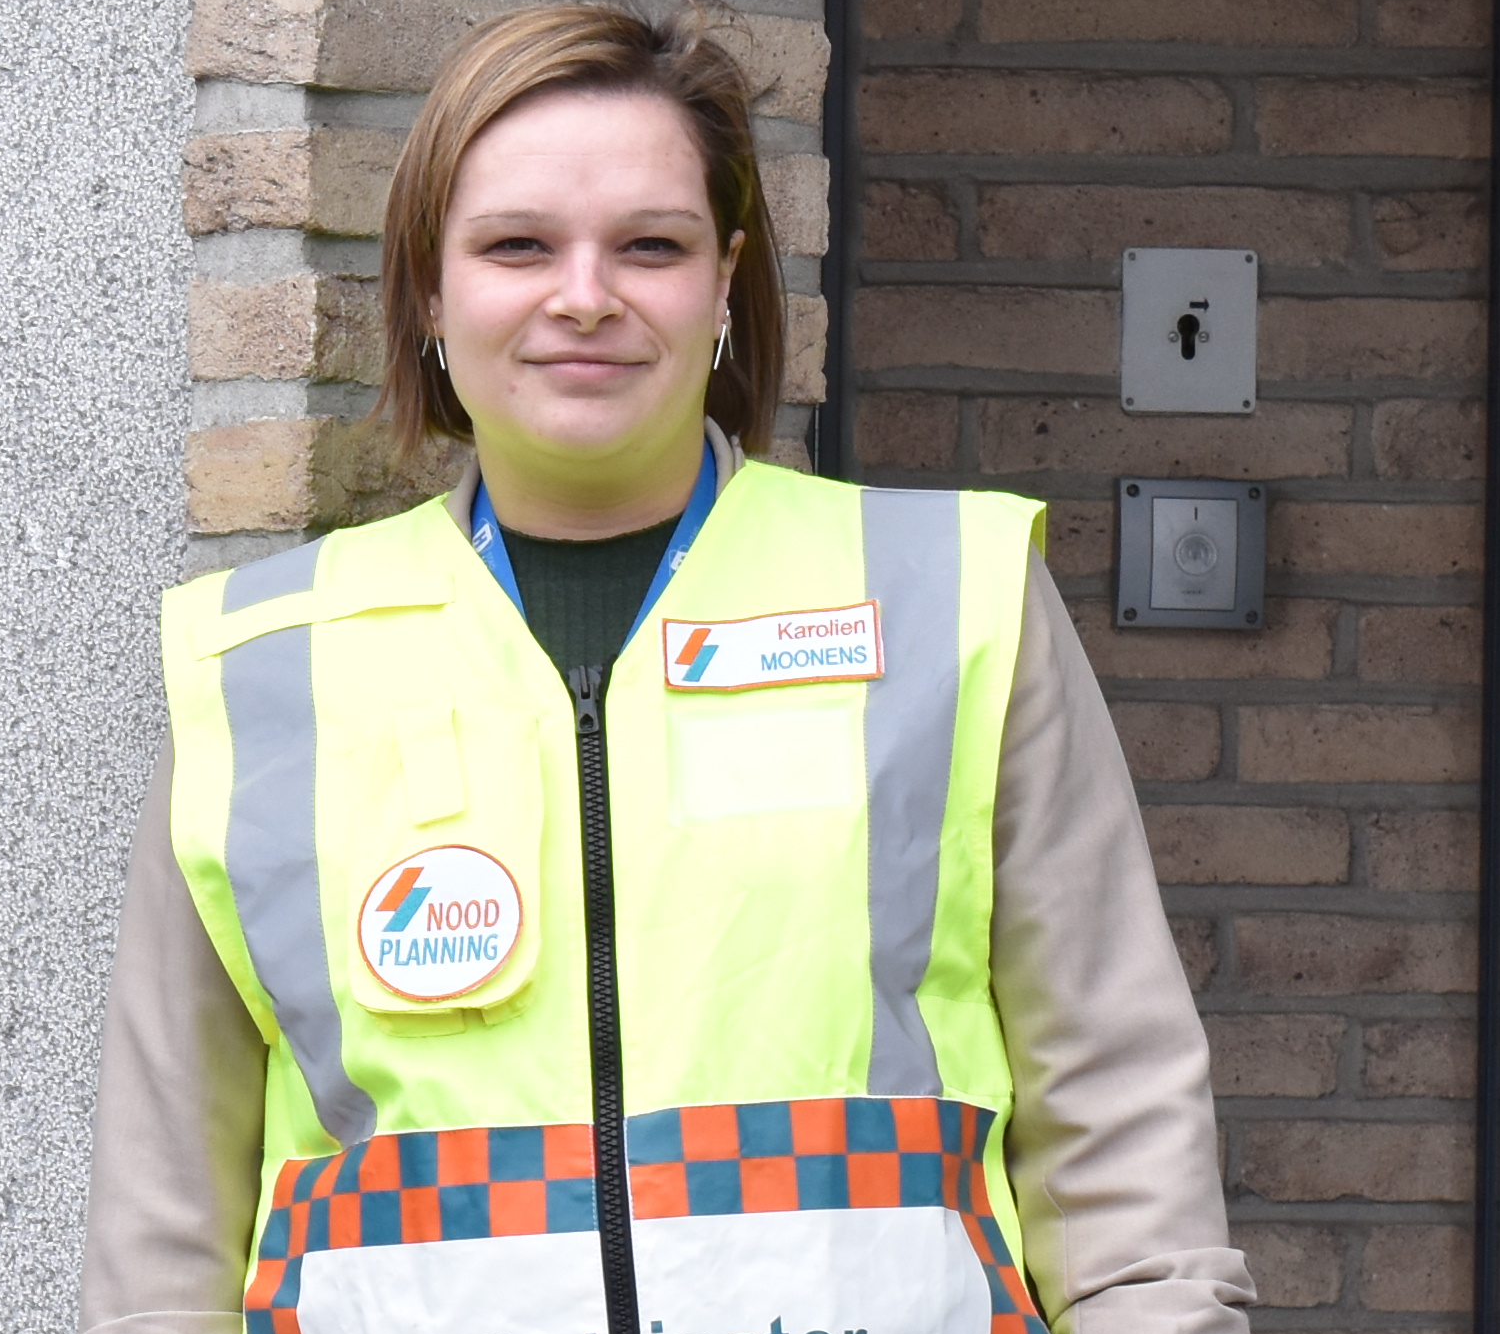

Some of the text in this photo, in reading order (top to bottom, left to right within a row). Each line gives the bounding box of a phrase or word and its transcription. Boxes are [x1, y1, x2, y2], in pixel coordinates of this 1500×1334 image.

[777, 618, 867, 641] Karolien
[760, 644, 868, 672] MOONENS
[426, 898, 500, 932] NOOD
[378, 933, 499, 967] PLANNING
